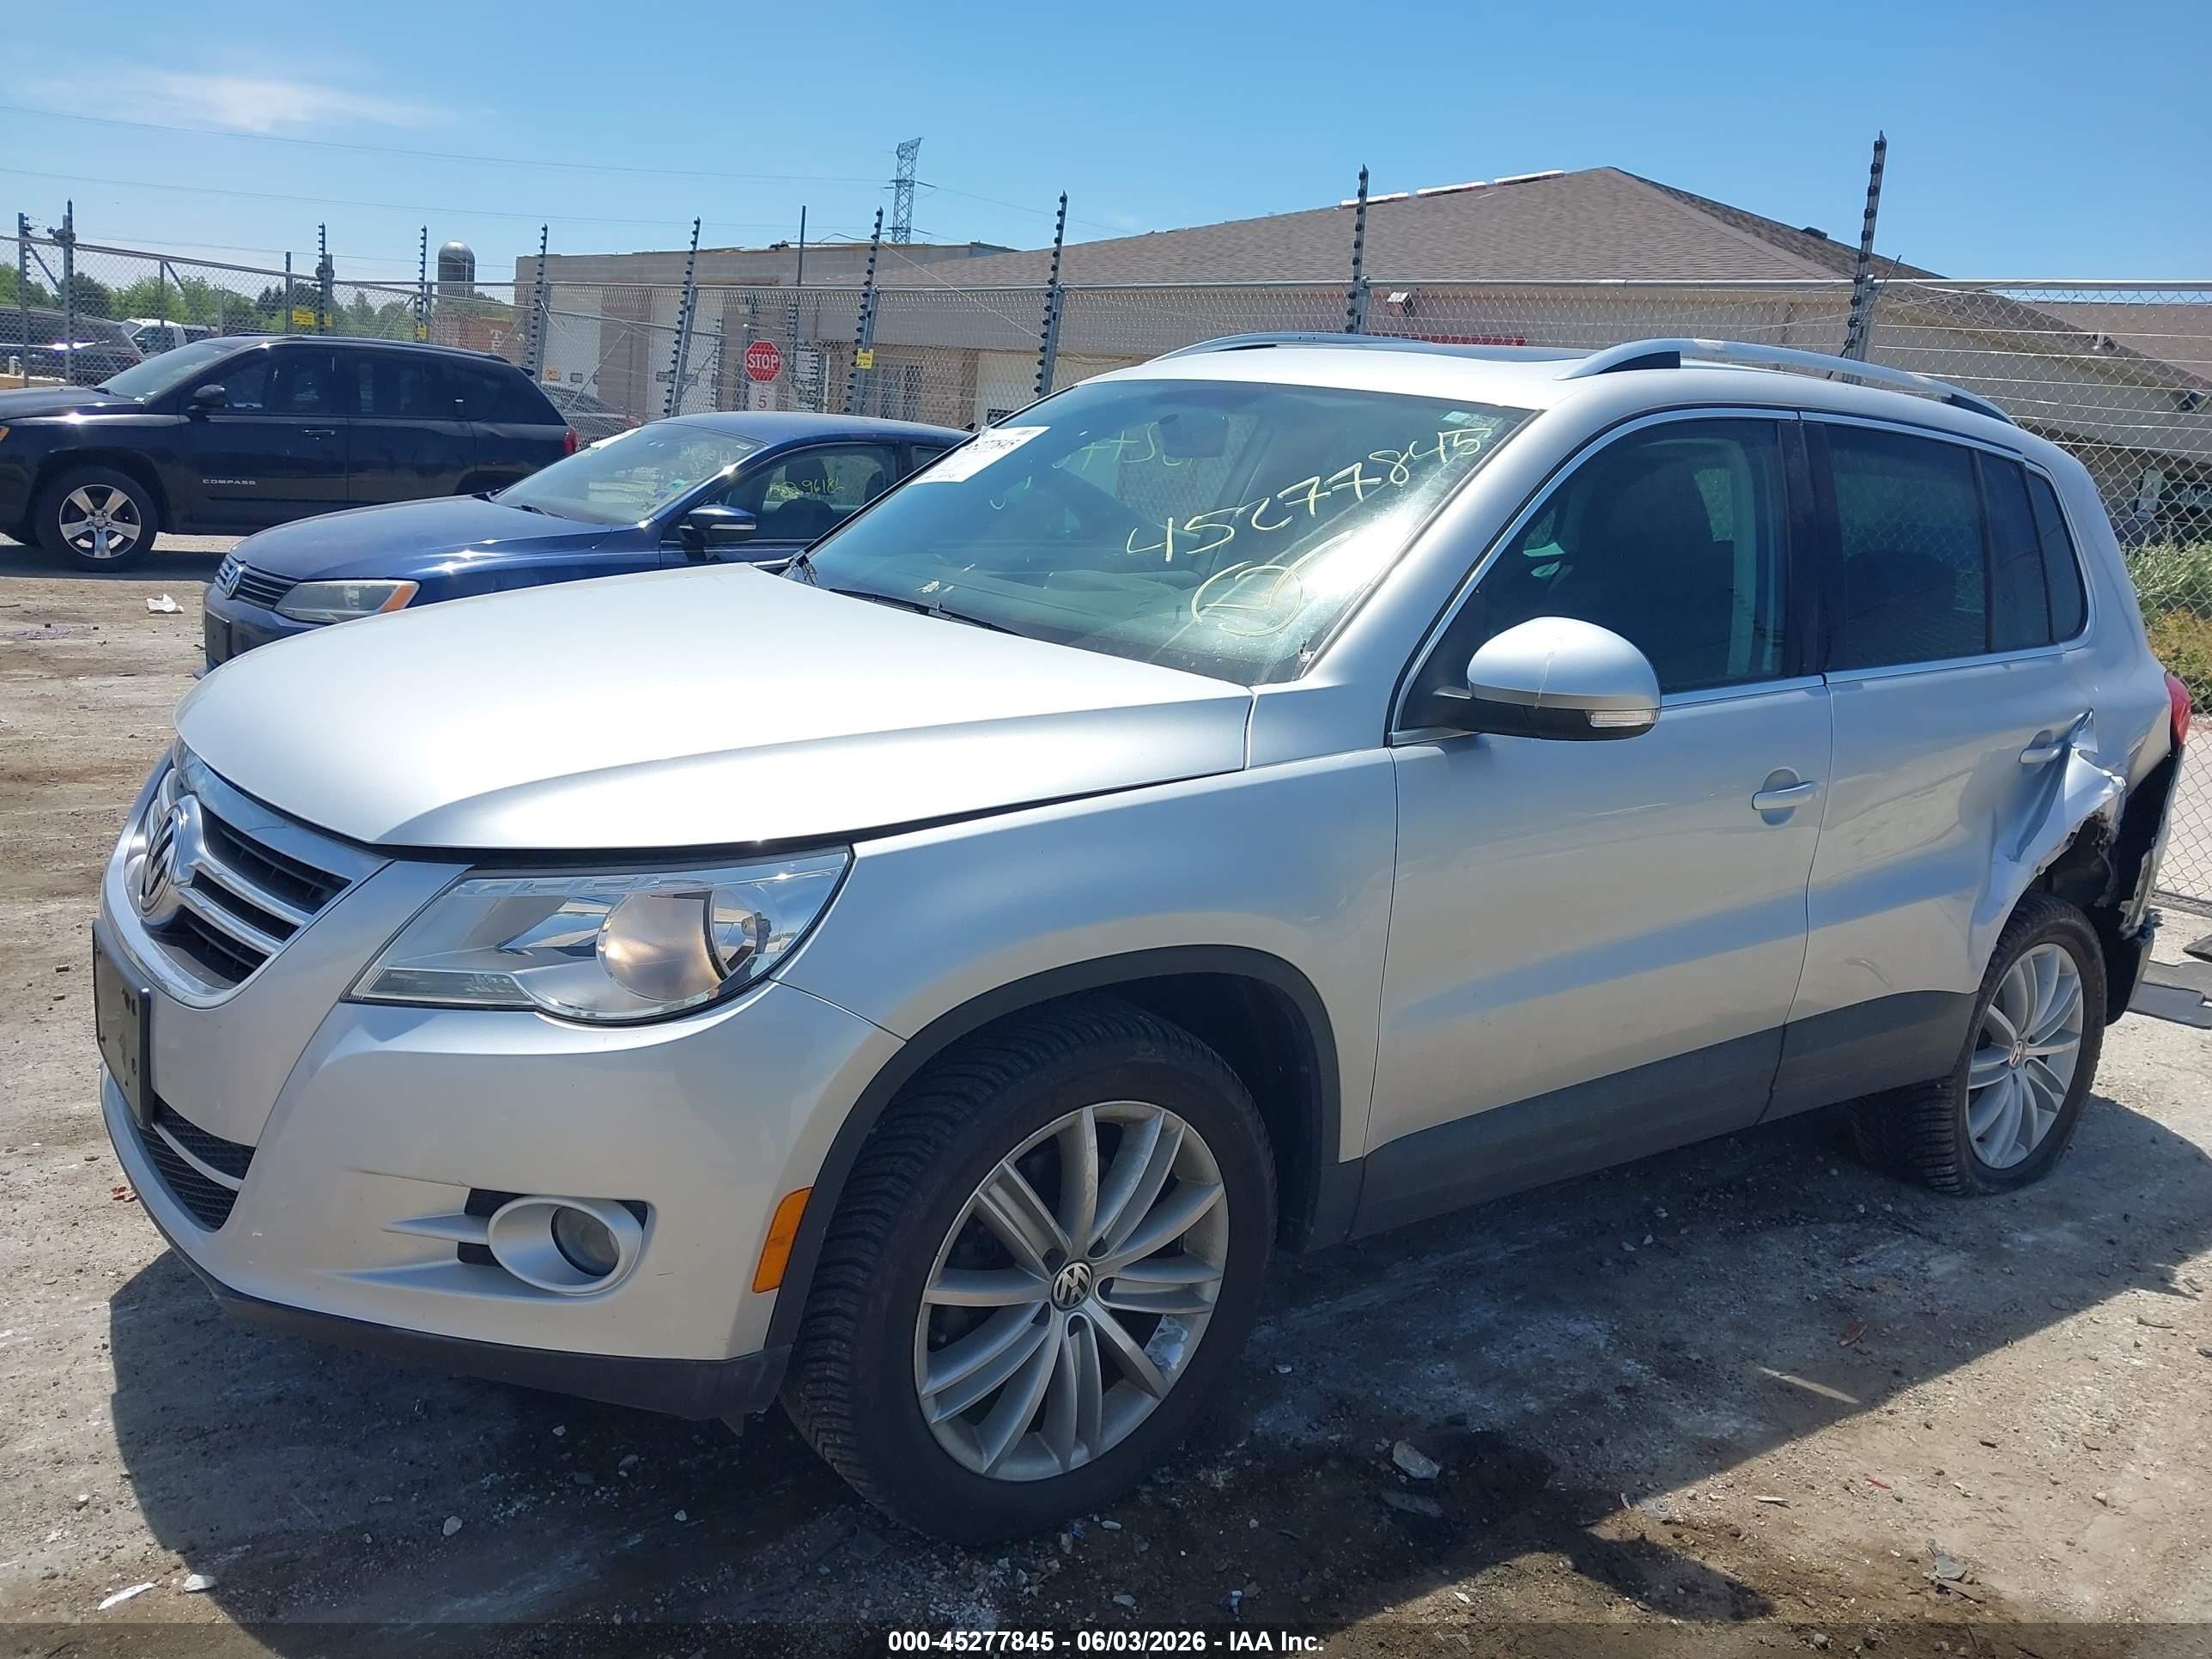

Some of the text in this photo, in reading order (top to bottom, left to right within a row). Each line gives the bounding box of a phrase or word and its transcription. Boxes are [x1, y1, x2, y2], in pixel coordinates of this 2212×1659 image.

[747, 353, 779, 370] STOP
[757, 395, 768, 409] 5
[1127, 428, 1492, 563] 45277845
